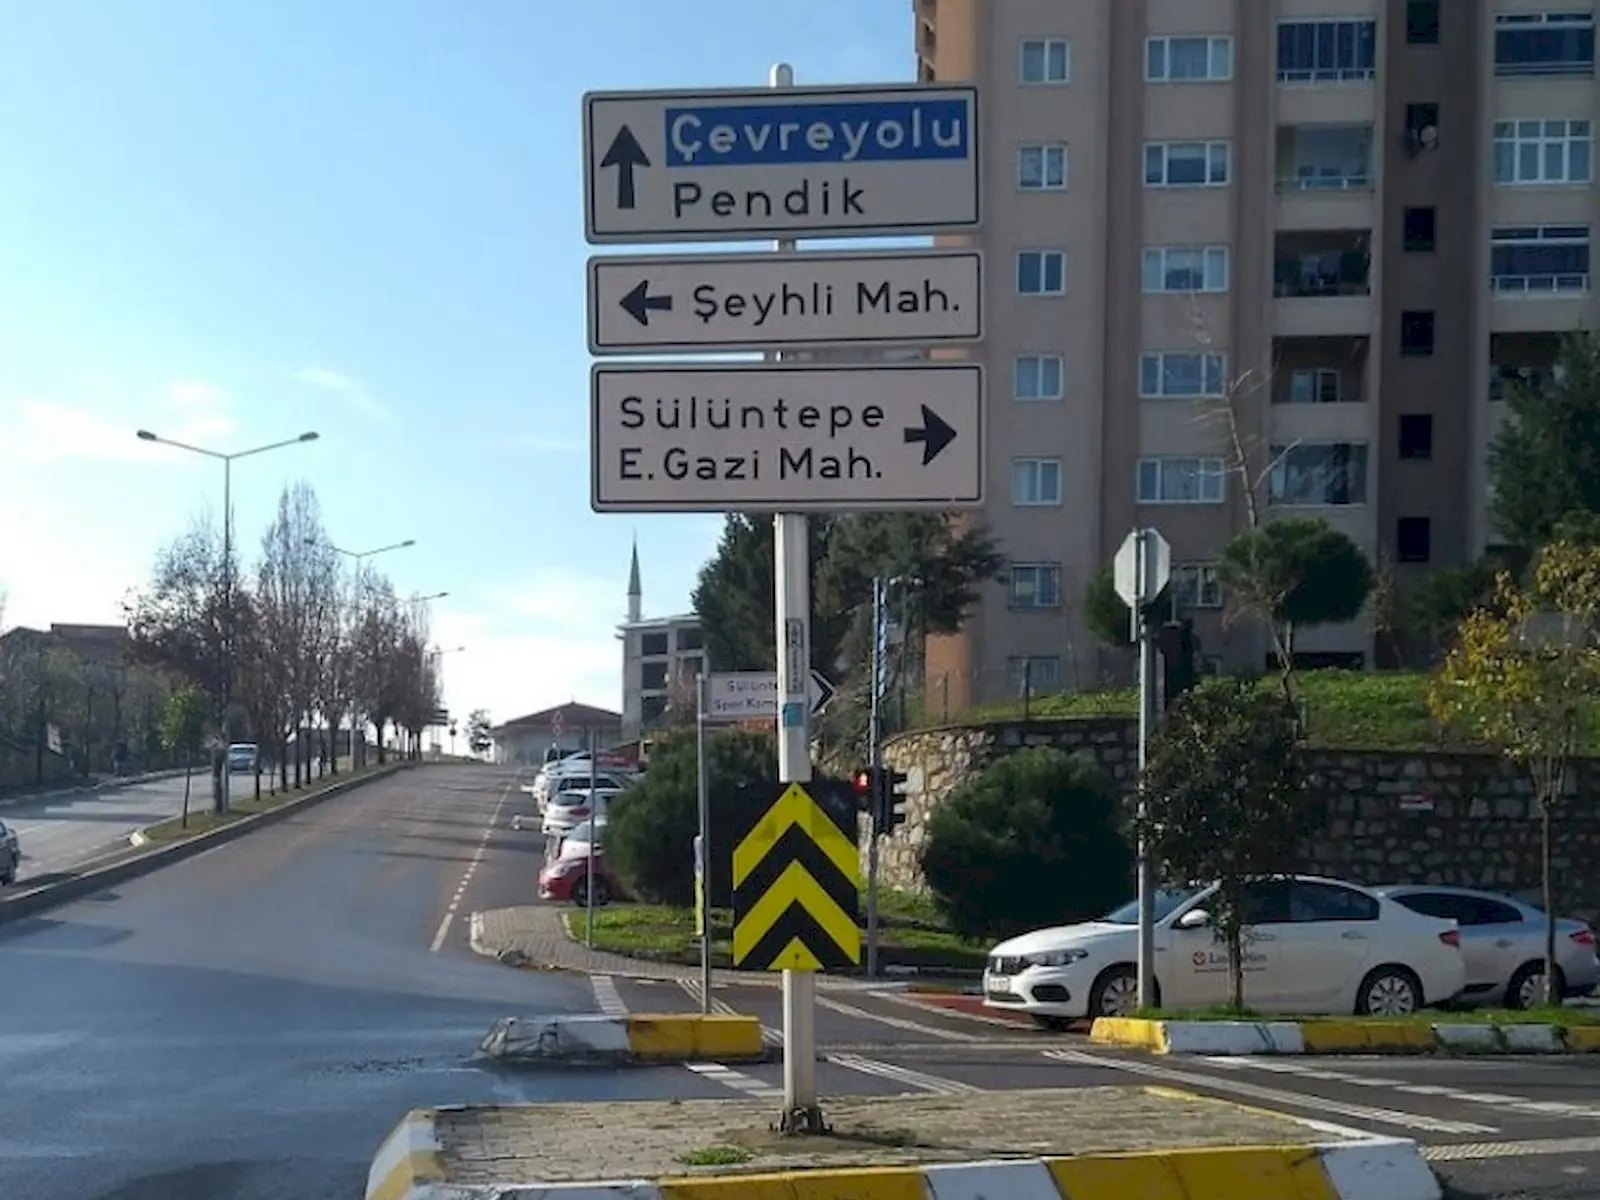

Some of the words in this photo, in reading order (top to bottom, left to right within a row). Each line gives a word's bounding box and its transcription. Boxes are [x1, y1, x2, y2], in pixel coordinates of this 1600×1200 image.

[671, 107, 962, 162] Çevreyolu
[673, 177, 865, 219] Pendik
[692, 281, 834, 327] Şeyhli
[856, 278, 960, 316] Mah.
[619, 395, 885, 439] Sülüntepe
[779, 446, 883, 481] Mah.
